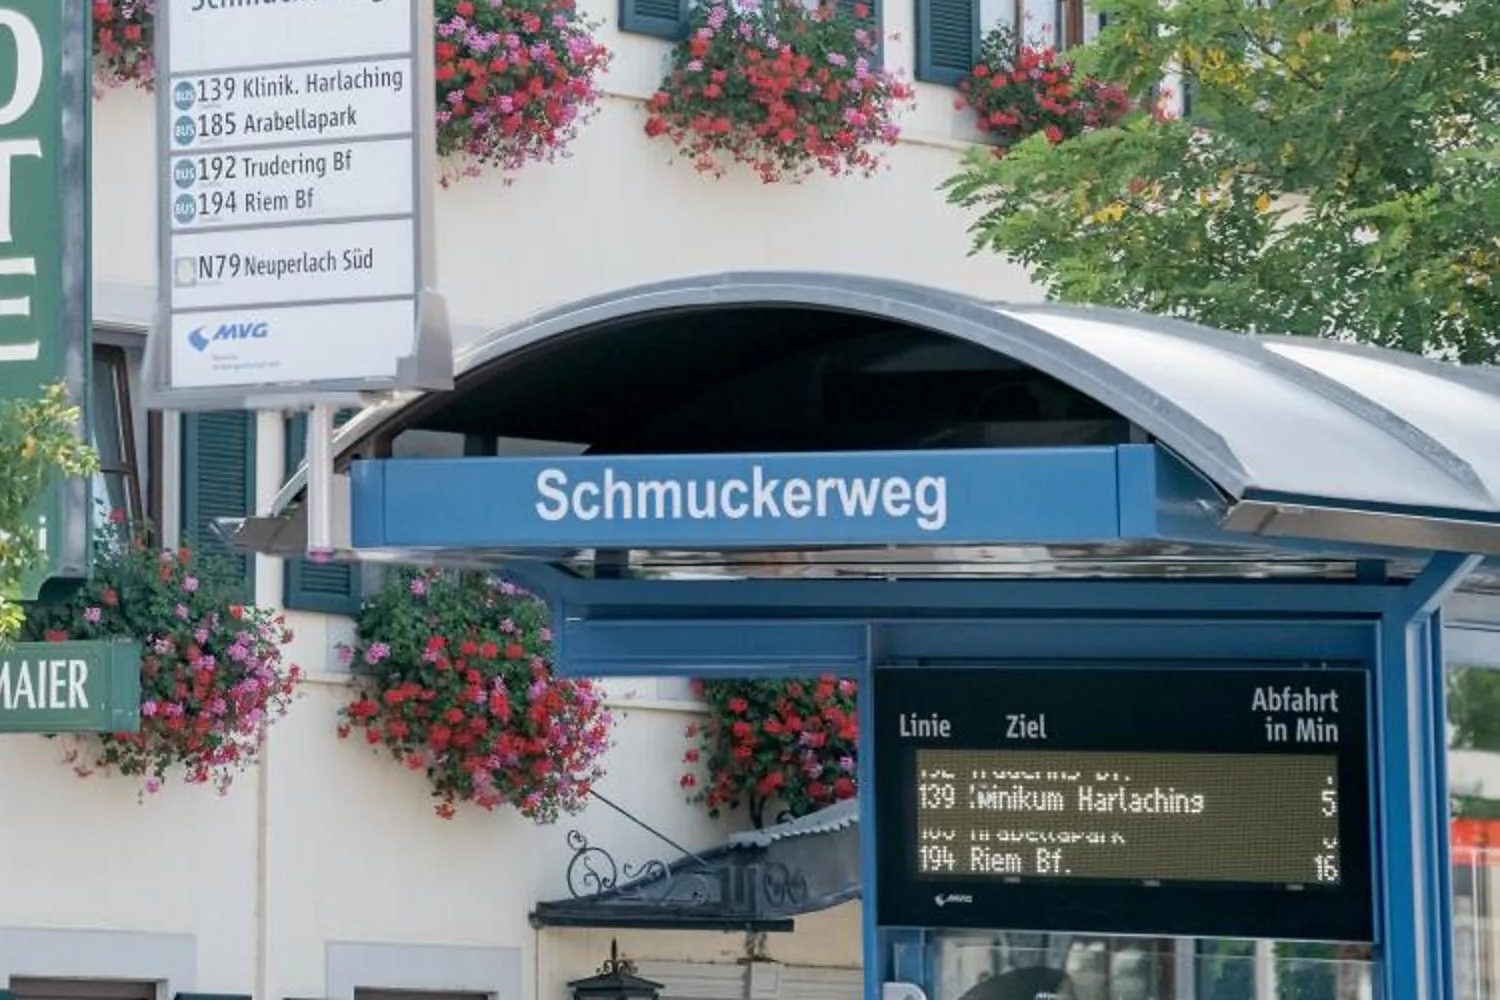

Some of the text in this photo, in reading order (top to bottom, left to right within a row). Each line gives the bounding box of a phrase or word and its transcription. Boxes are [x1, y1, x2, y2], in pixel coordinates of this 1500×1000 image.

[197, 77, 235, 102] 139
[243, 74, 299, 98] Klinik.
[306, 65, 403, 93] Harlaching
[198, 112, 236, 136] 185
[243, 104, 357, 134] Arabellapark
[198, 155, 236, 181] 192
[242, 152, 326, 178] Trudering
[333, 149, 352, 171] Bf
[198, 191, 236, 215] 194
[245, 191, 289, 212] Riem
[295, 187, 314, 209] Bf
[199, 247, 373, 279] N79 Neuperlach Süd
[212, 322, 269, 341] MVG
[536, 466, 948, 531] Schmuckerweg
[1251, 686, 1339, 712] Abfahrt
[899, 712, 1048, 739] Linie Ziel
[1265, 716, 1339, 743] in Min
[918, 783, 956, 809] 139
[1321, 790, 1338, 817] 5
[918, 845, 1339, 881] 194 Riem Bf. 16
